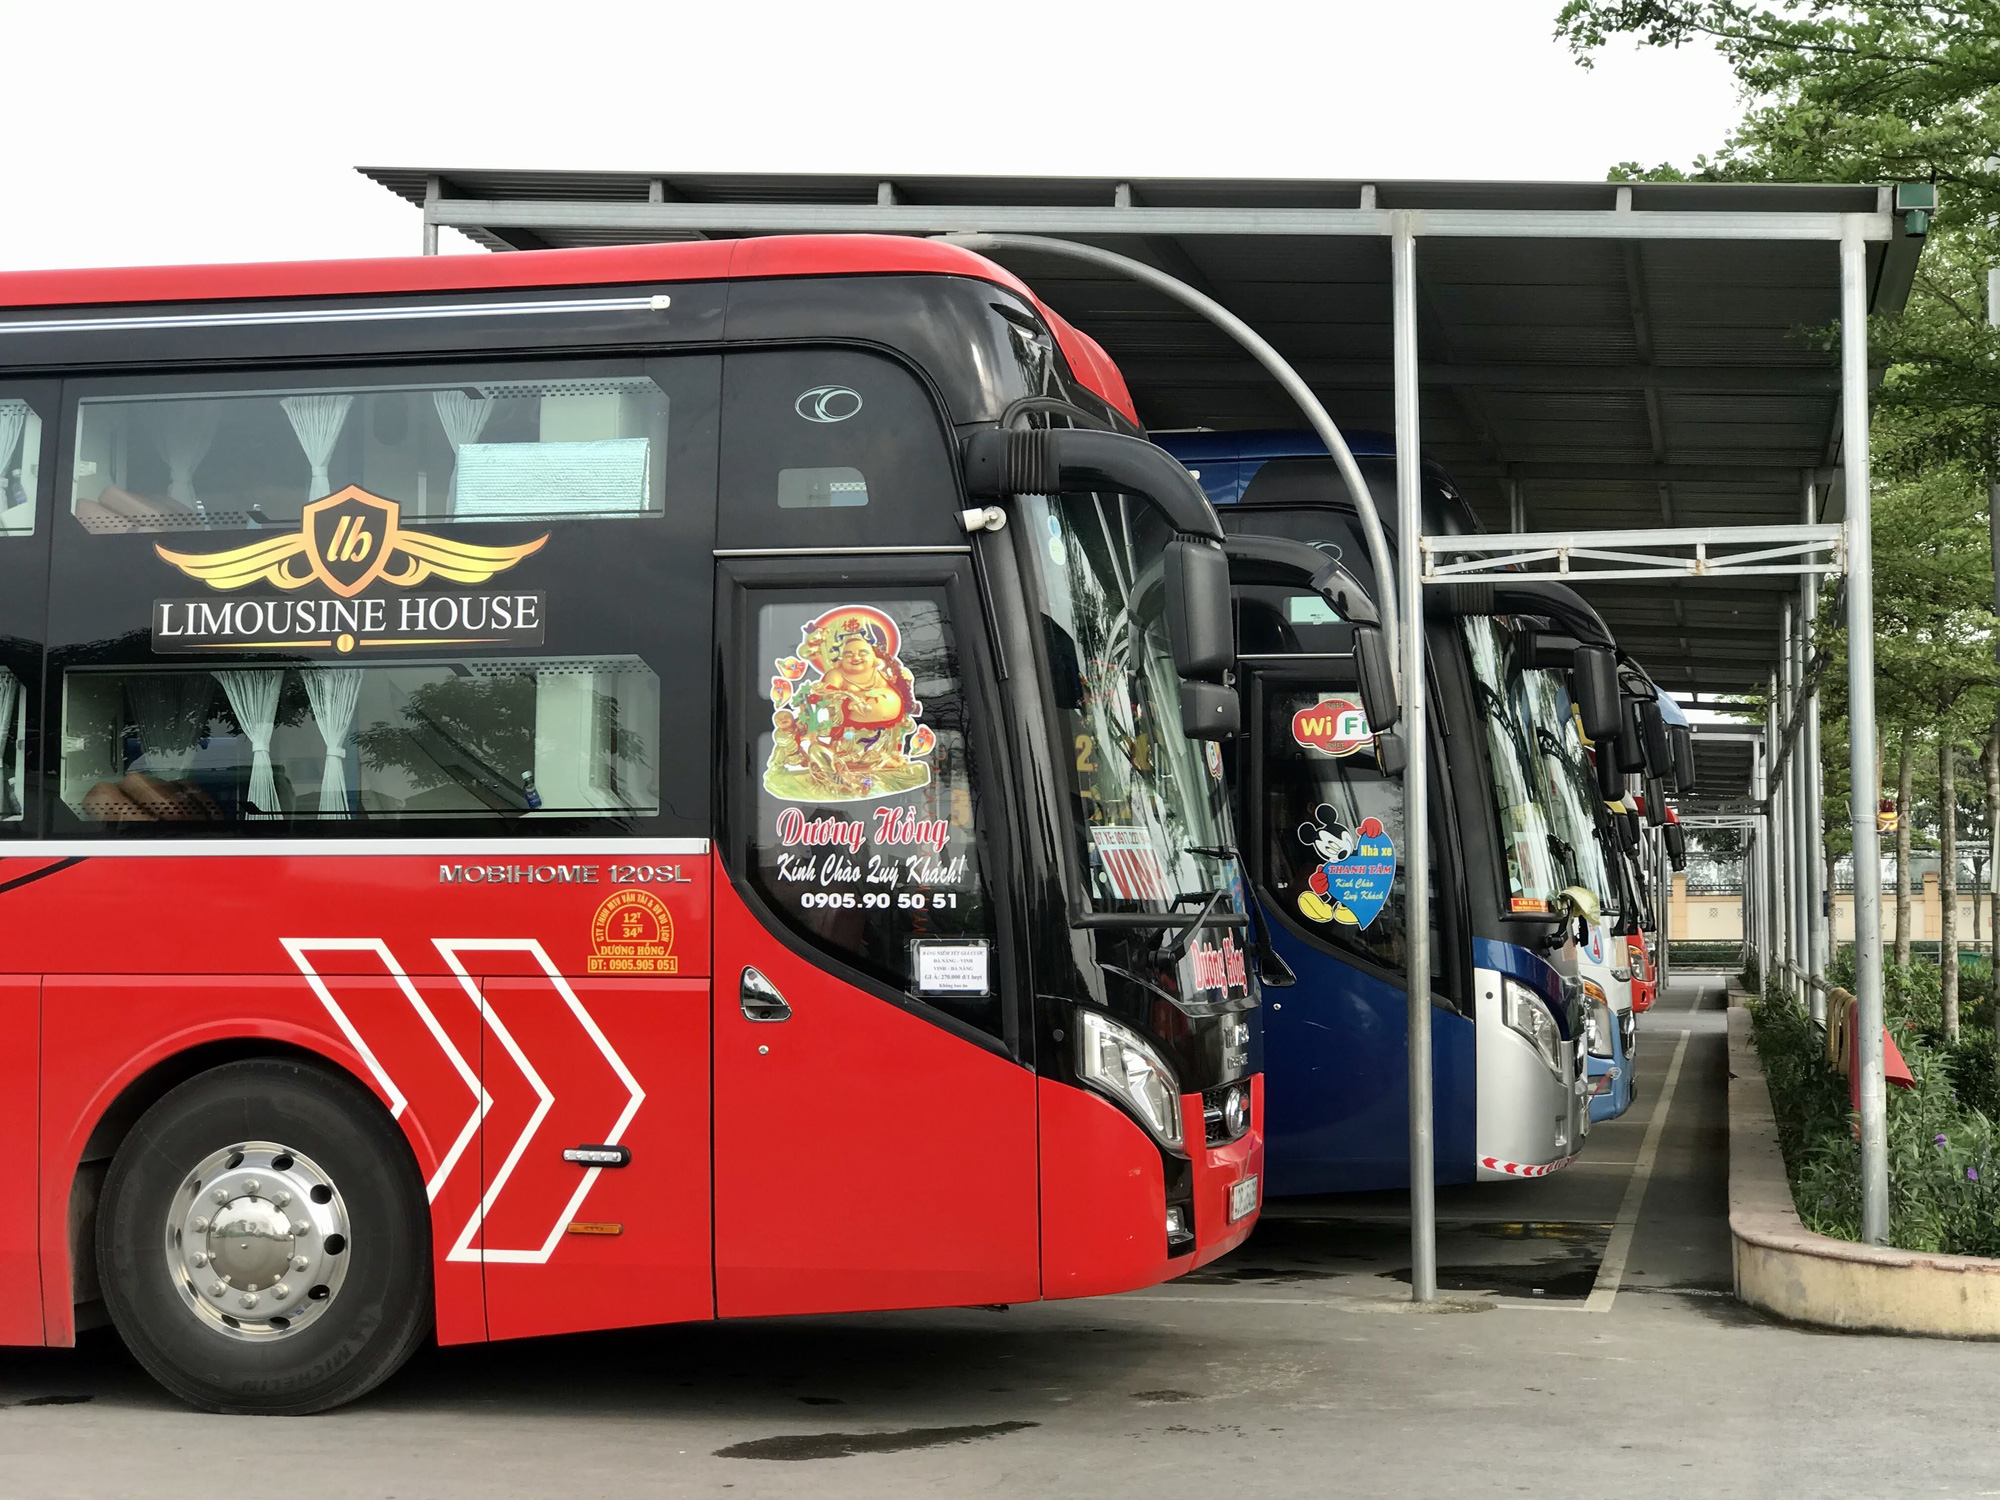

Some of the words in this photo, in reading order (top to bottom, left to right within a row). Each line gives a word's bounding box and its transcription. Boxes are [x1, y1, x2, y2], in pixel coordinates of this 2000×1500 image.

[158, 599, 387, 636] LIMOUSINE
[391, 595, 540, 632] HOUSE
[776, 806, 866, 854] Dương
[873, 805, 951, 853] Hồng
[1360, 844, 1379, 857] Nhà
[439, 864, 600, 884] MOBIHOME
[607, 864, 692, 884] 120SL
[776, 853, 817, 883] Kính
[820, 853, 862, 887] Chào
[866, 854, 899, 891] Quý
[905, 854, 966, 884] Khách!
[1328, 865, 1366, 874] THANH
[1368, 863, 1392, 875] TÂM
[800, 892, 891, 909] 0905.90
[897, 893, 926, 909] 50
[932, 893, 957, 909] 51
[596, 908, 610, 926] TNHH
[595, 928, 605, 942] CTY
[600, 944, 635, 956] DƯƠNG
[609, 959, 655, 970] 0905.905
[656, 959, 676, 970] 051
